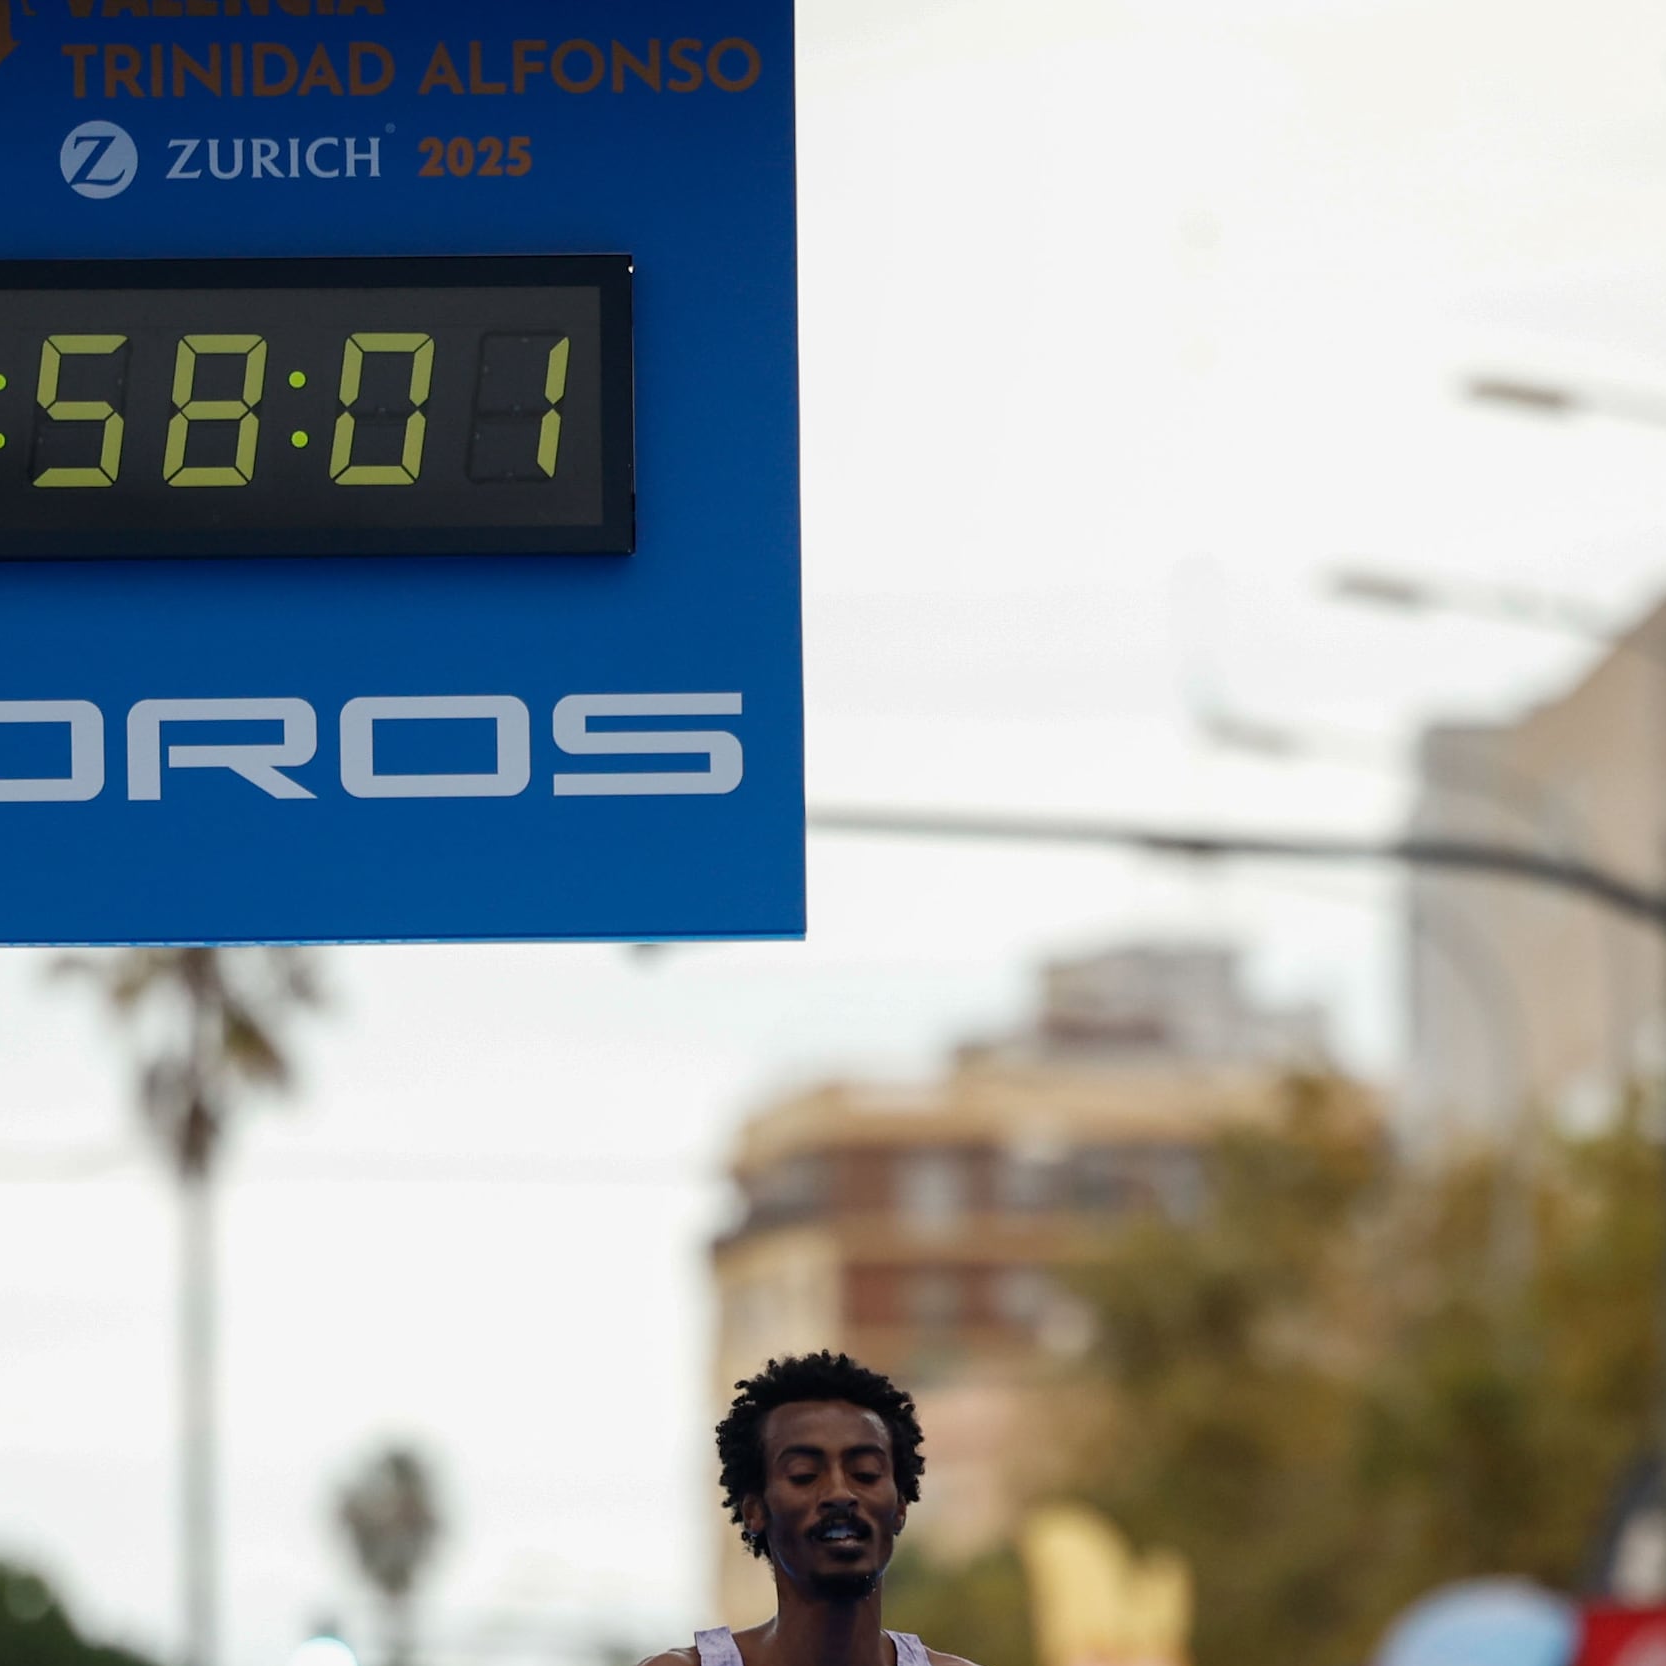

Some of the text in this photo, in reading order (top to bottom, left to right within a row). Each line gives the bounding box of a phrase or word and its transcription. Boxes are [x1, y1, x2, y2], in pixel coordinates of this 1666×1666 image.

[60, 37, 762, 98] TRINIDAD ALFONSO
[165, 136, 382, 180] ZURICH
[417, 136, 533, 178] 2025
